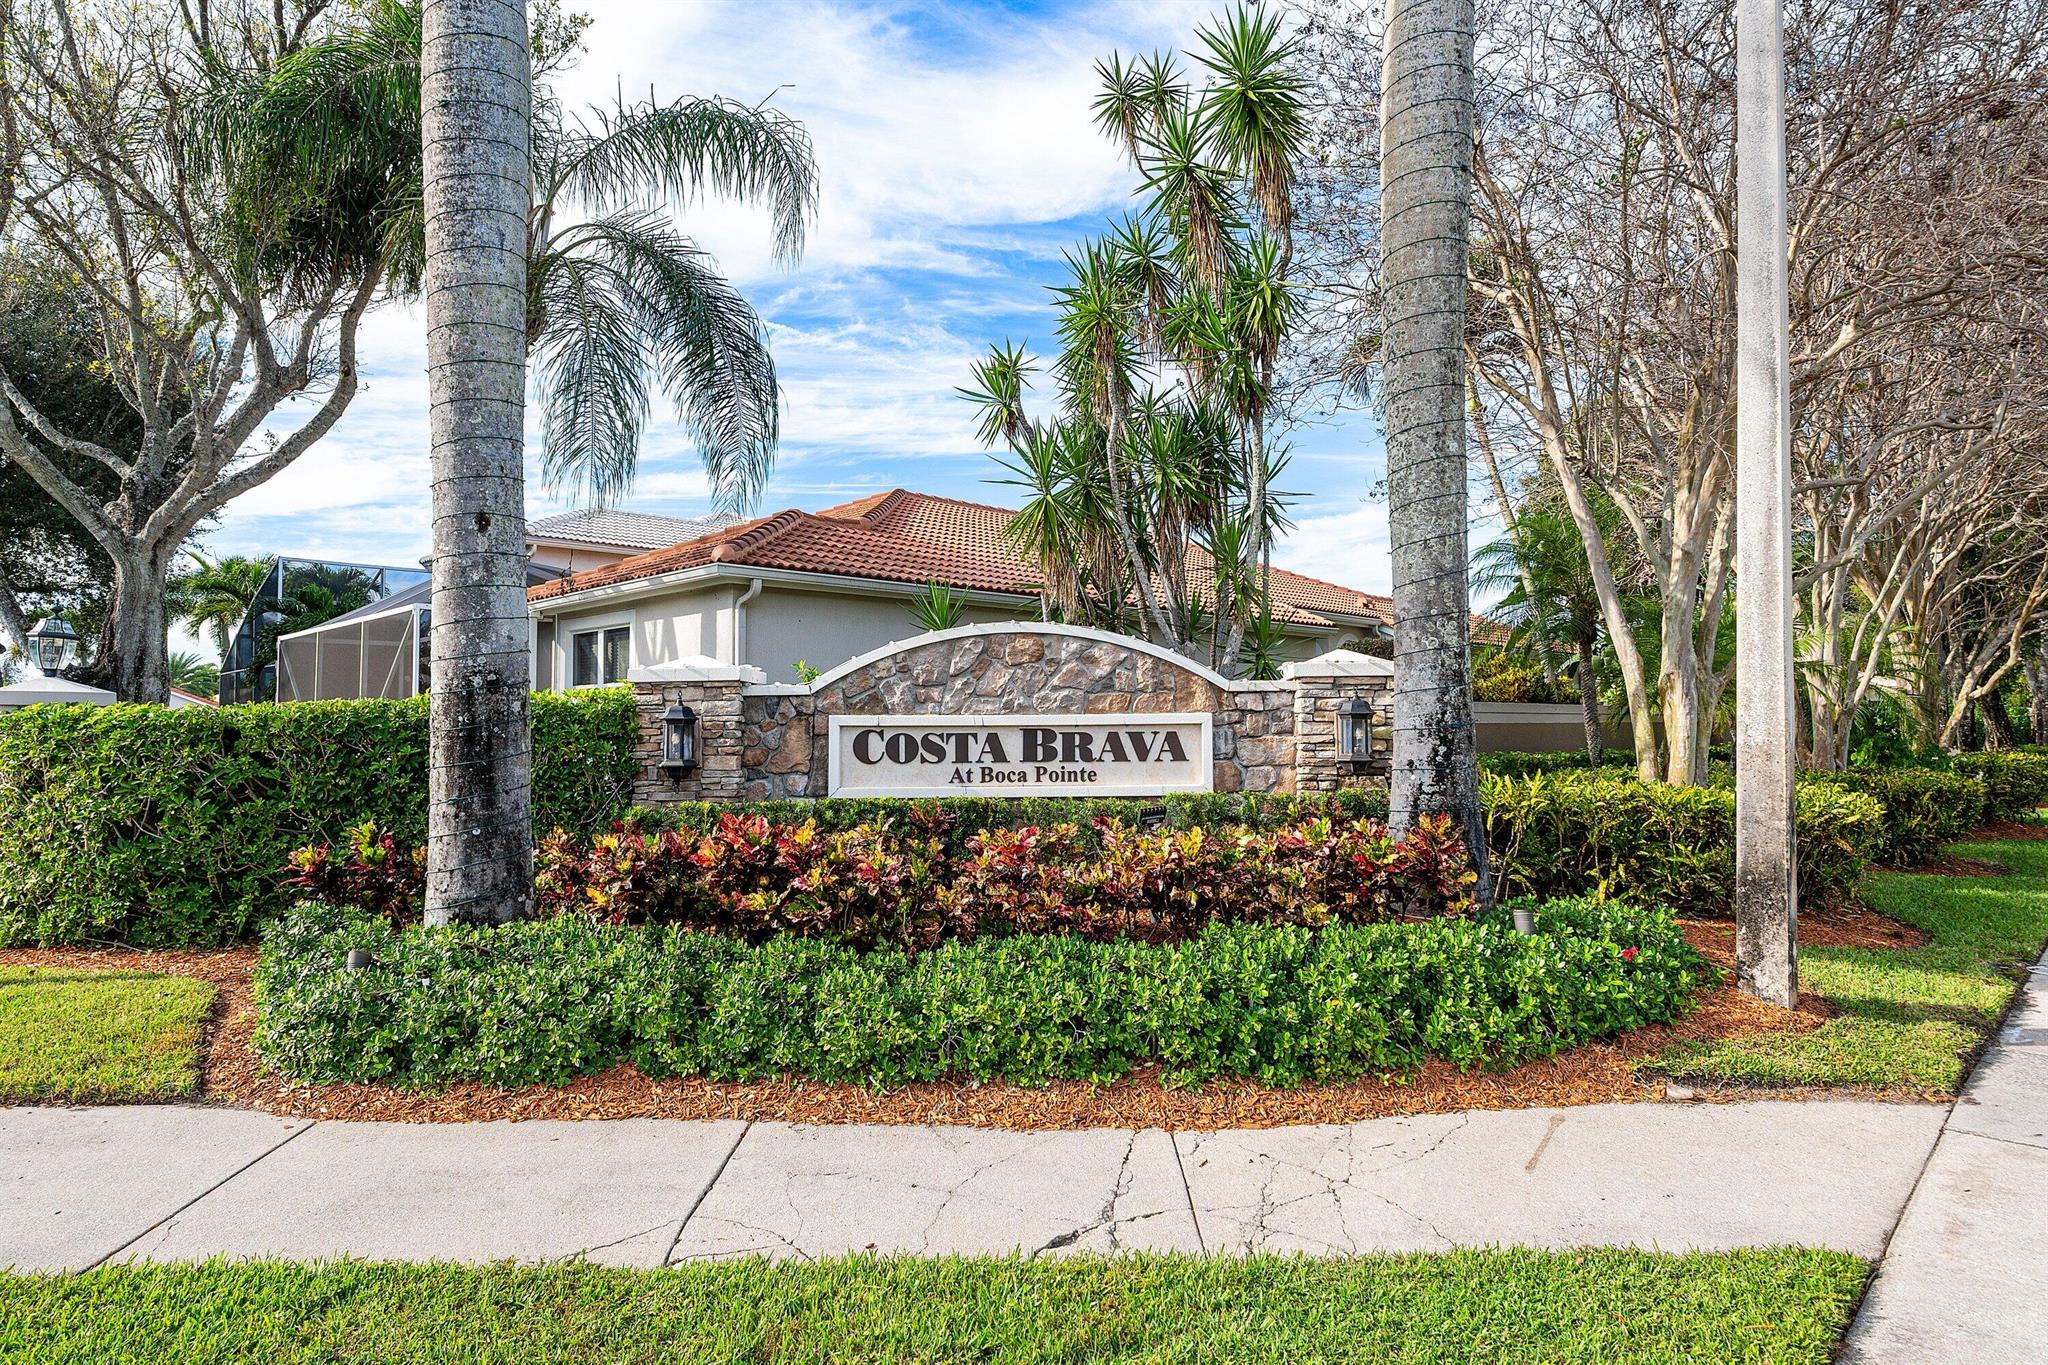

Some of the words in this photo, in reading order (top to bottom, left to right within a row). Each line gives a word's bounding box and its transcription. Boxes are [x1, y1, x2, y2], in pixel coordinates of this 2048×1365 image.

[852, 729, 1010, 765] COSTA
[1019, 728, 1189, 763] BRAVA
[949, 766, 973, 784] At
[979, 767, 1027, 784] Boca
[1034, 766, 1097, 783] Pointe
